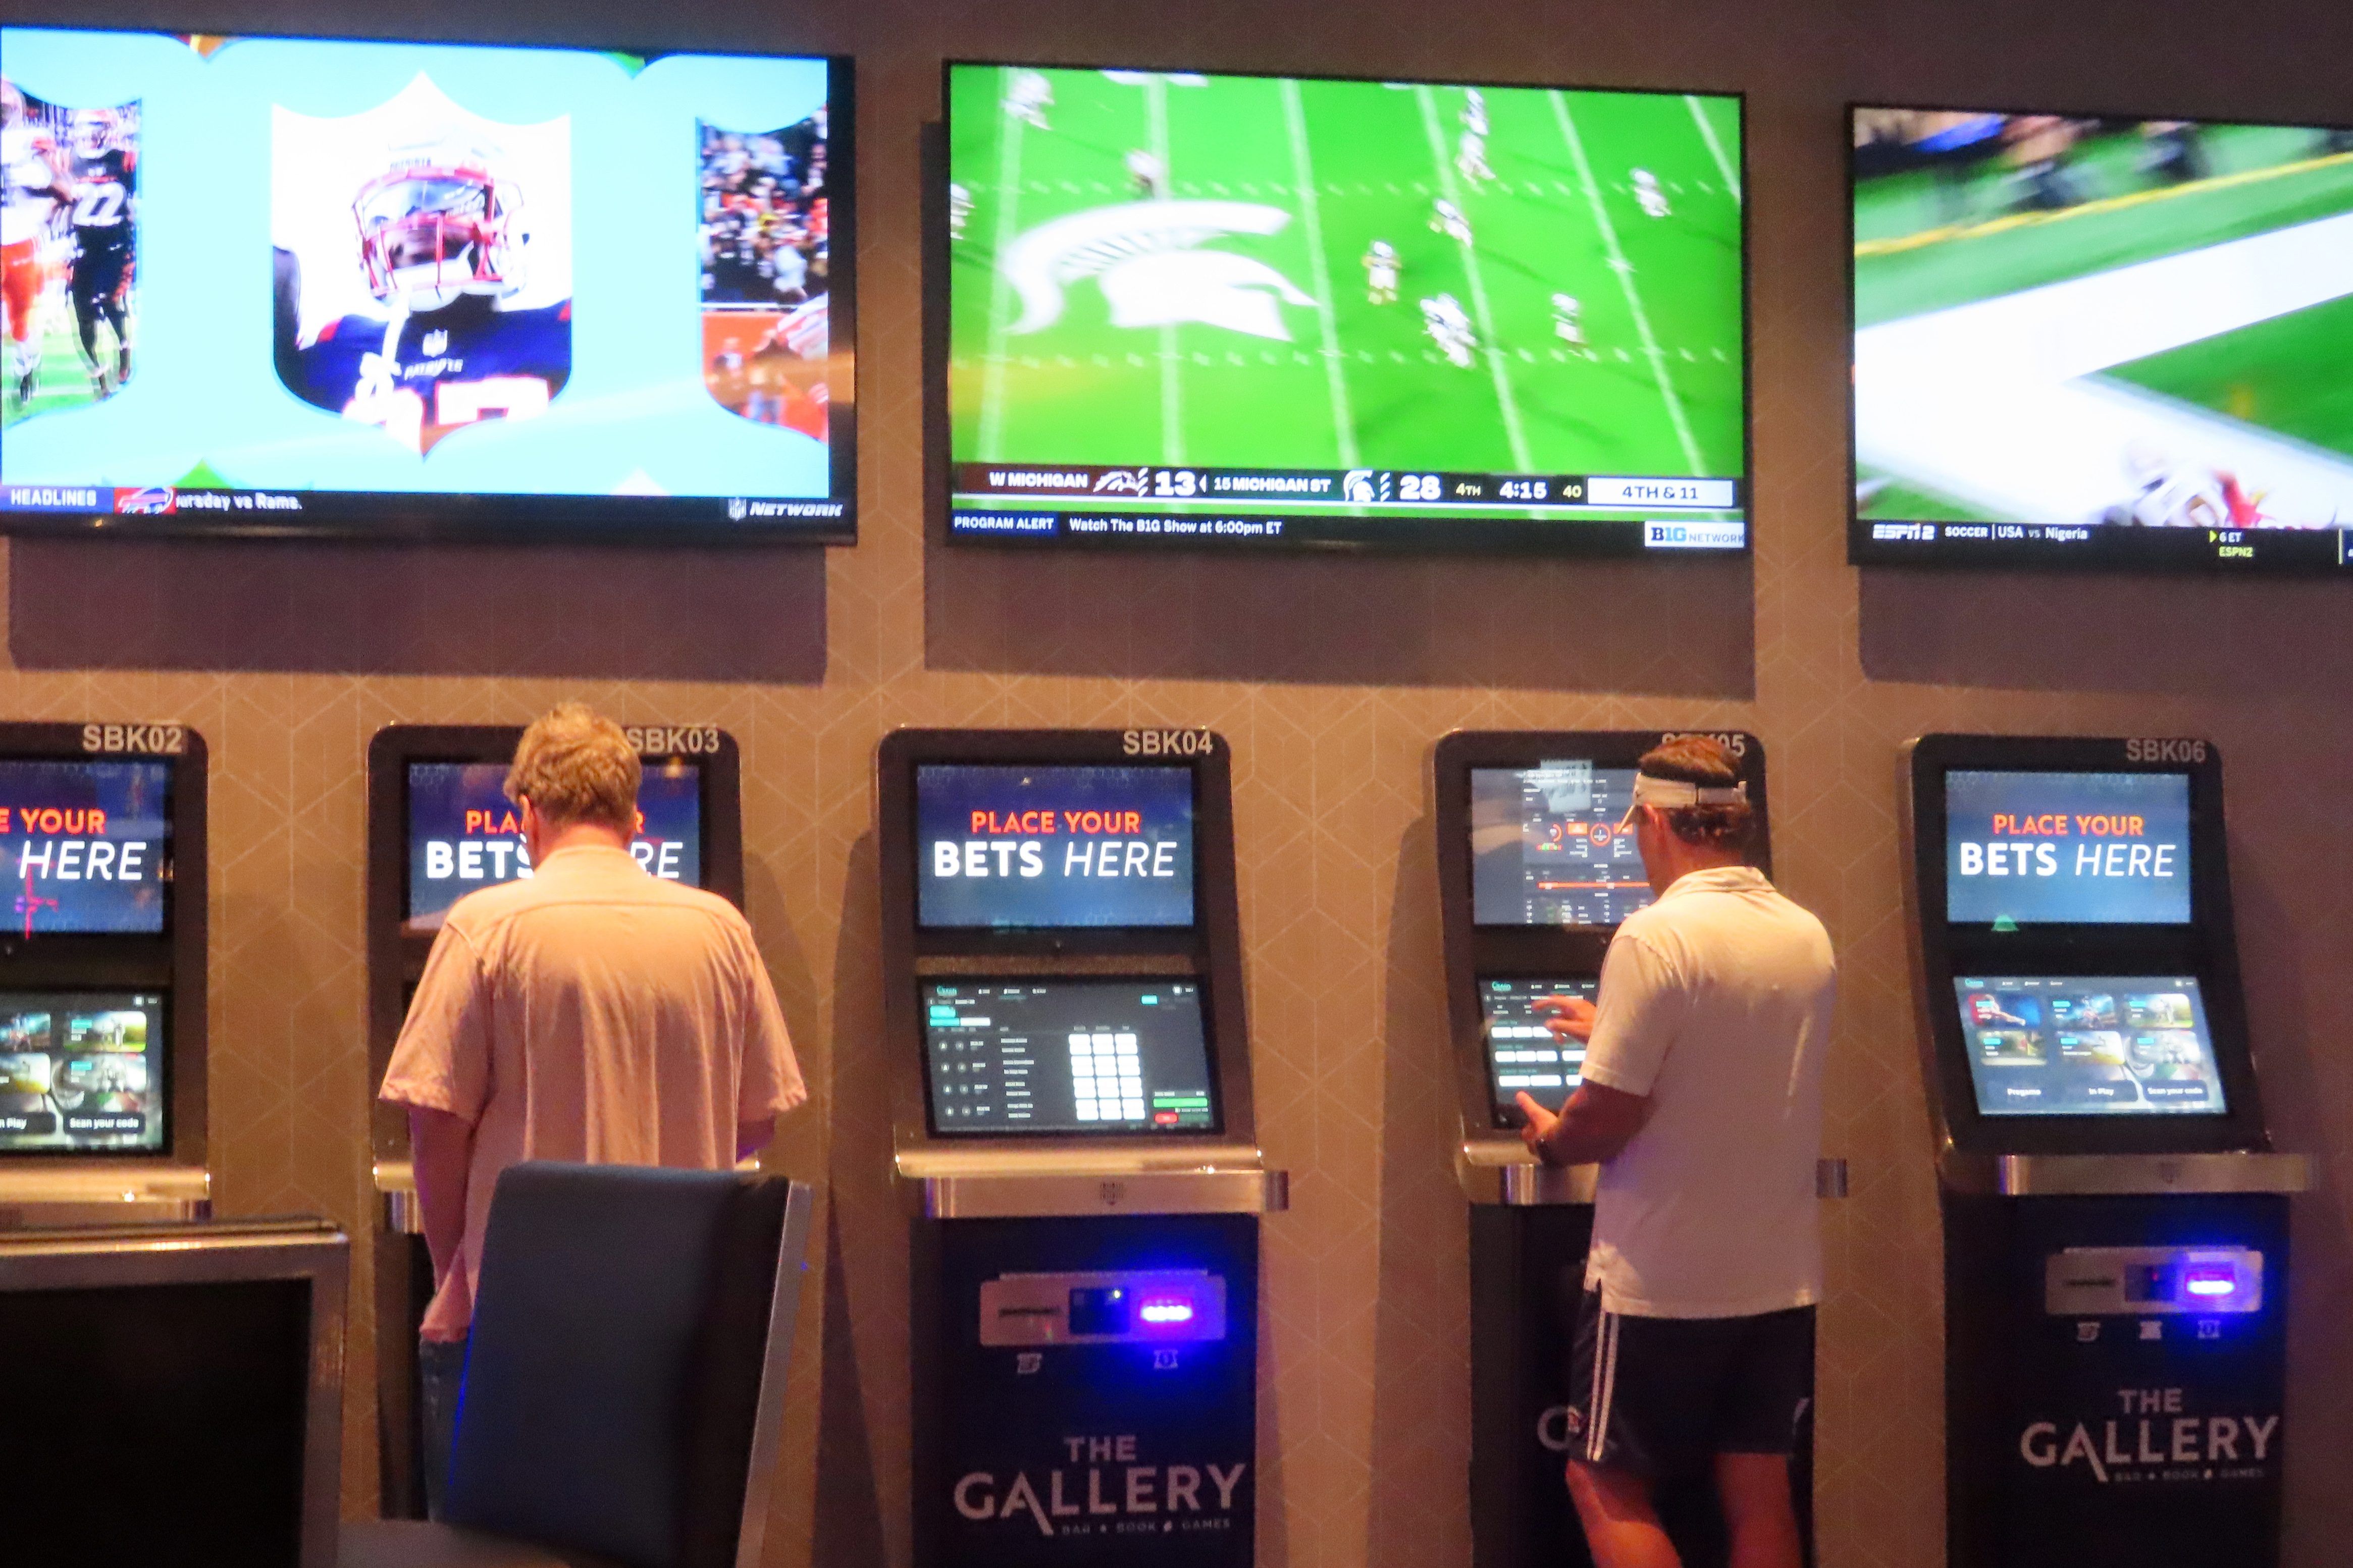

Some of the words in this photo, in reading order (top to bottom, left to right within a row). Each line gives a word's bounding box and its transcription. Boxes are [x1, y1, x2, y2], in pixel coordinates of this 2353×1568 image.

[72, 183, 124, 227] 22
[989, 471, 1006, 486] W
[1008, 472, 1088, 488] MICHIGAN
[1155, 470, 1196, 496] 13
[1214, 476, 1231, 490] 15
[1233, 476, 1309, 492] MICHIGAN
[1310, 477, 1331, 493] ST
[1400, 474, 1441, 500] 28
[1455, 482, 1481, 497] 4TH
[1499, 480, 1548, 499] 4:15
[1562, 484, 1582, 498] 40
[1622, 486, 1658, 499] 4TH
[1662, 486, 1676, 499] &
[1680, 487, 1699, 500] 11
[11, 488, 97, 507] HEADLINES
[175, 492, 231, 512] ursday
[233, 495, 253, 509] vs
[750, 501, 844, 517] NETWORK
[954, 515, 1014, 529] PROGRAM
[1016, 517, 1054, 530] ALERT
[1069, 517, 1108, 531] Watch
[1110, 518, 1134, 532] The
[1164, 519, 1196, 533] Show
[1199, 521, 1212, 534] at
[1215, 520, 1263, 536] 6:00pm
[1266, 521, 1282, 534] ET
[1689, 533, 1744, 543] NETWORK
[1945, 525, 1989, 538] SOCCER
[1997, 525, 2024, 538] USA
[2028, 528, 2041, 538] vs
[2045, 526, 2088, 542] Nigeria
[2228, 532, 2242, 543] ET
[2218, 546, 2254, 558] ESPN2
[82, 724, 183, 753] SBK02
[626, 728, 720, 754] SBK03
[1122, 730, 1213, 755] SBK04
[2126, 738, 2206, 764] SBK06
[20, 808, 107, 835] YOUR
[465, 808, 520, 835] PLA
[971, 810, 1056, 834] PLACE
[1064, 810, 1141, 834] YOUR
[1993, 814, 2068, 836] PLACE
[2075, 815, 2145, 836] YOUR
[19, 839, 147, 881] HERE
[630, 841, 684, 879] RE
[934, 840, 1043, 878] BETS
[1064, 841, 1178, 877] HERE
[1960, 842, 2058, 877] BETS
[2075, 843, 2176, 877] HERE
[7, 1117, 27, 1129] Play
[2118, 1388, 2183, 1413] THE
[1064, 1435, 1136, 1462] THE
[2020, 1416, 2279, 1482] GALLERY
[954, 1464, 1245, 1536] GALLERY
